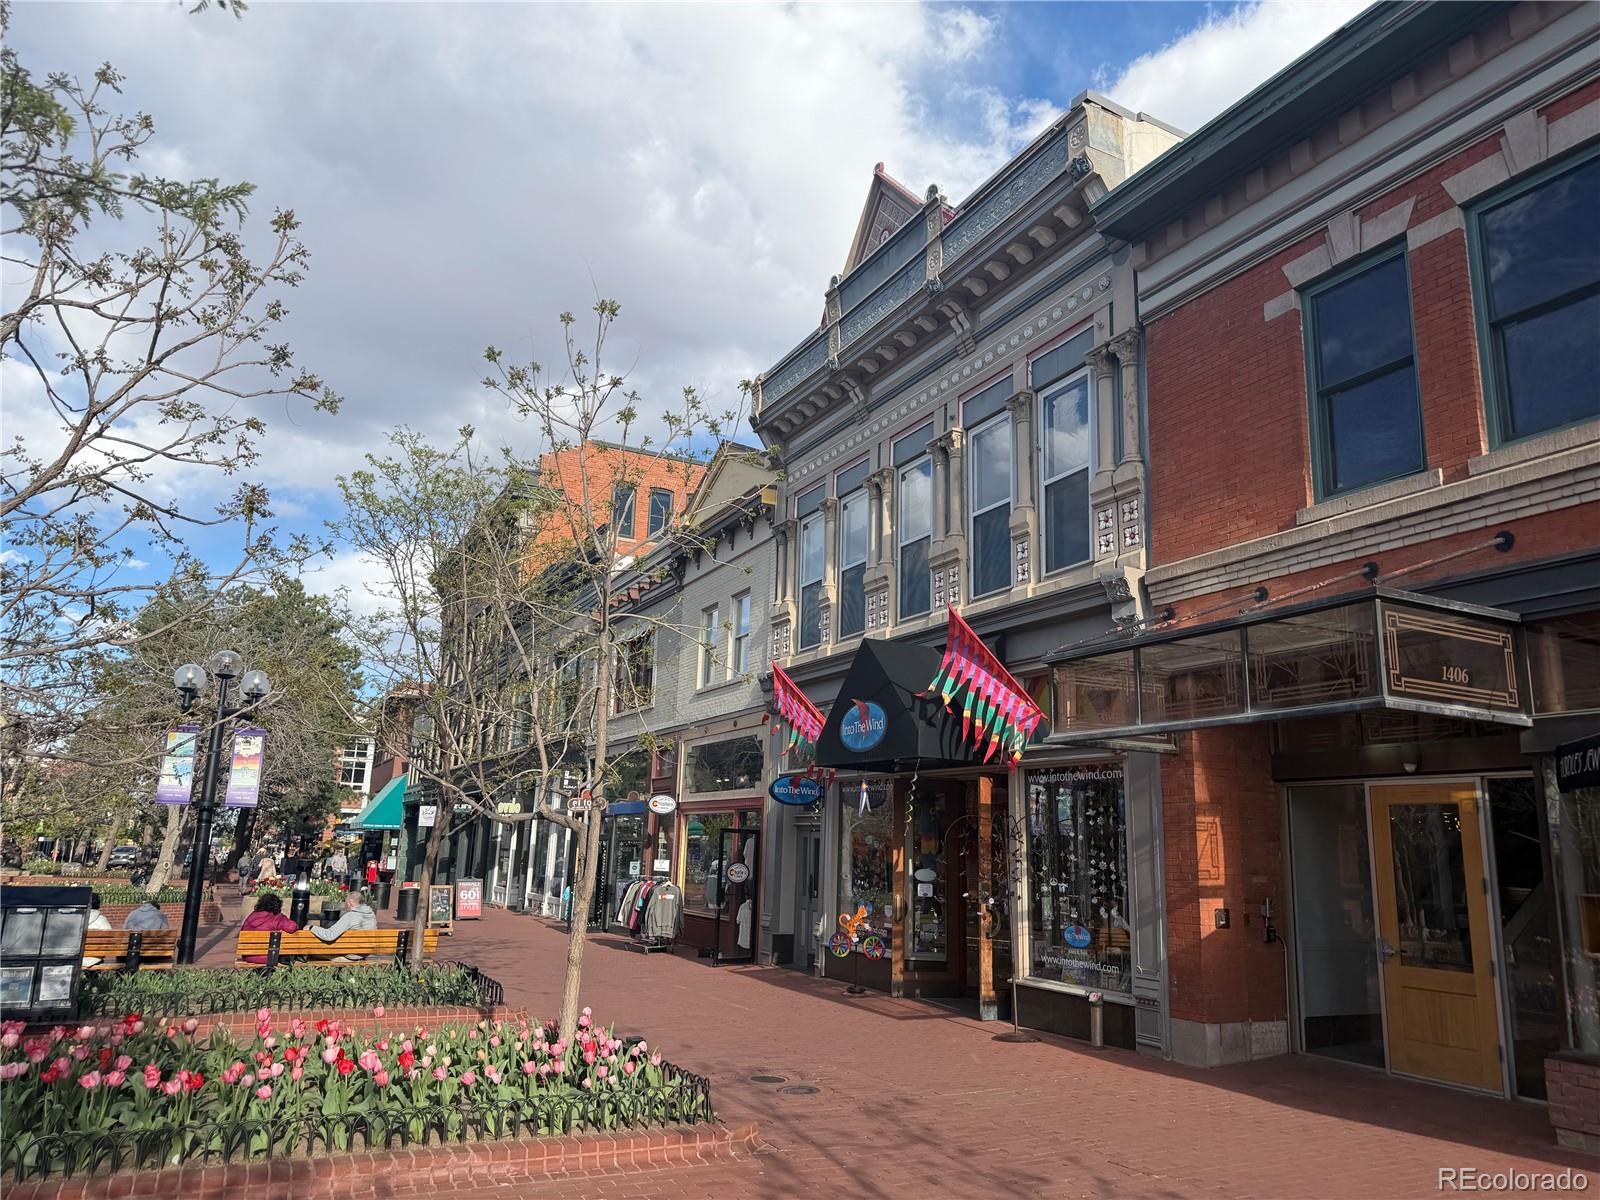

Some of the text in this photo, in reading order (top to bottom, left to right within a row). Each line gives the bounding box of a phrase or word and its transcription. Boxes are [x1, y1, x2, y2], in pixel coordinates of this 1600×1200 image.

[1442, 666, 1469, 684] 1406
[1027, 768, 1122, 783] www.intothewind.com
[460, 890, 476, 900] 60
[1040, 954, 1120, 974] www.intothewind.com
